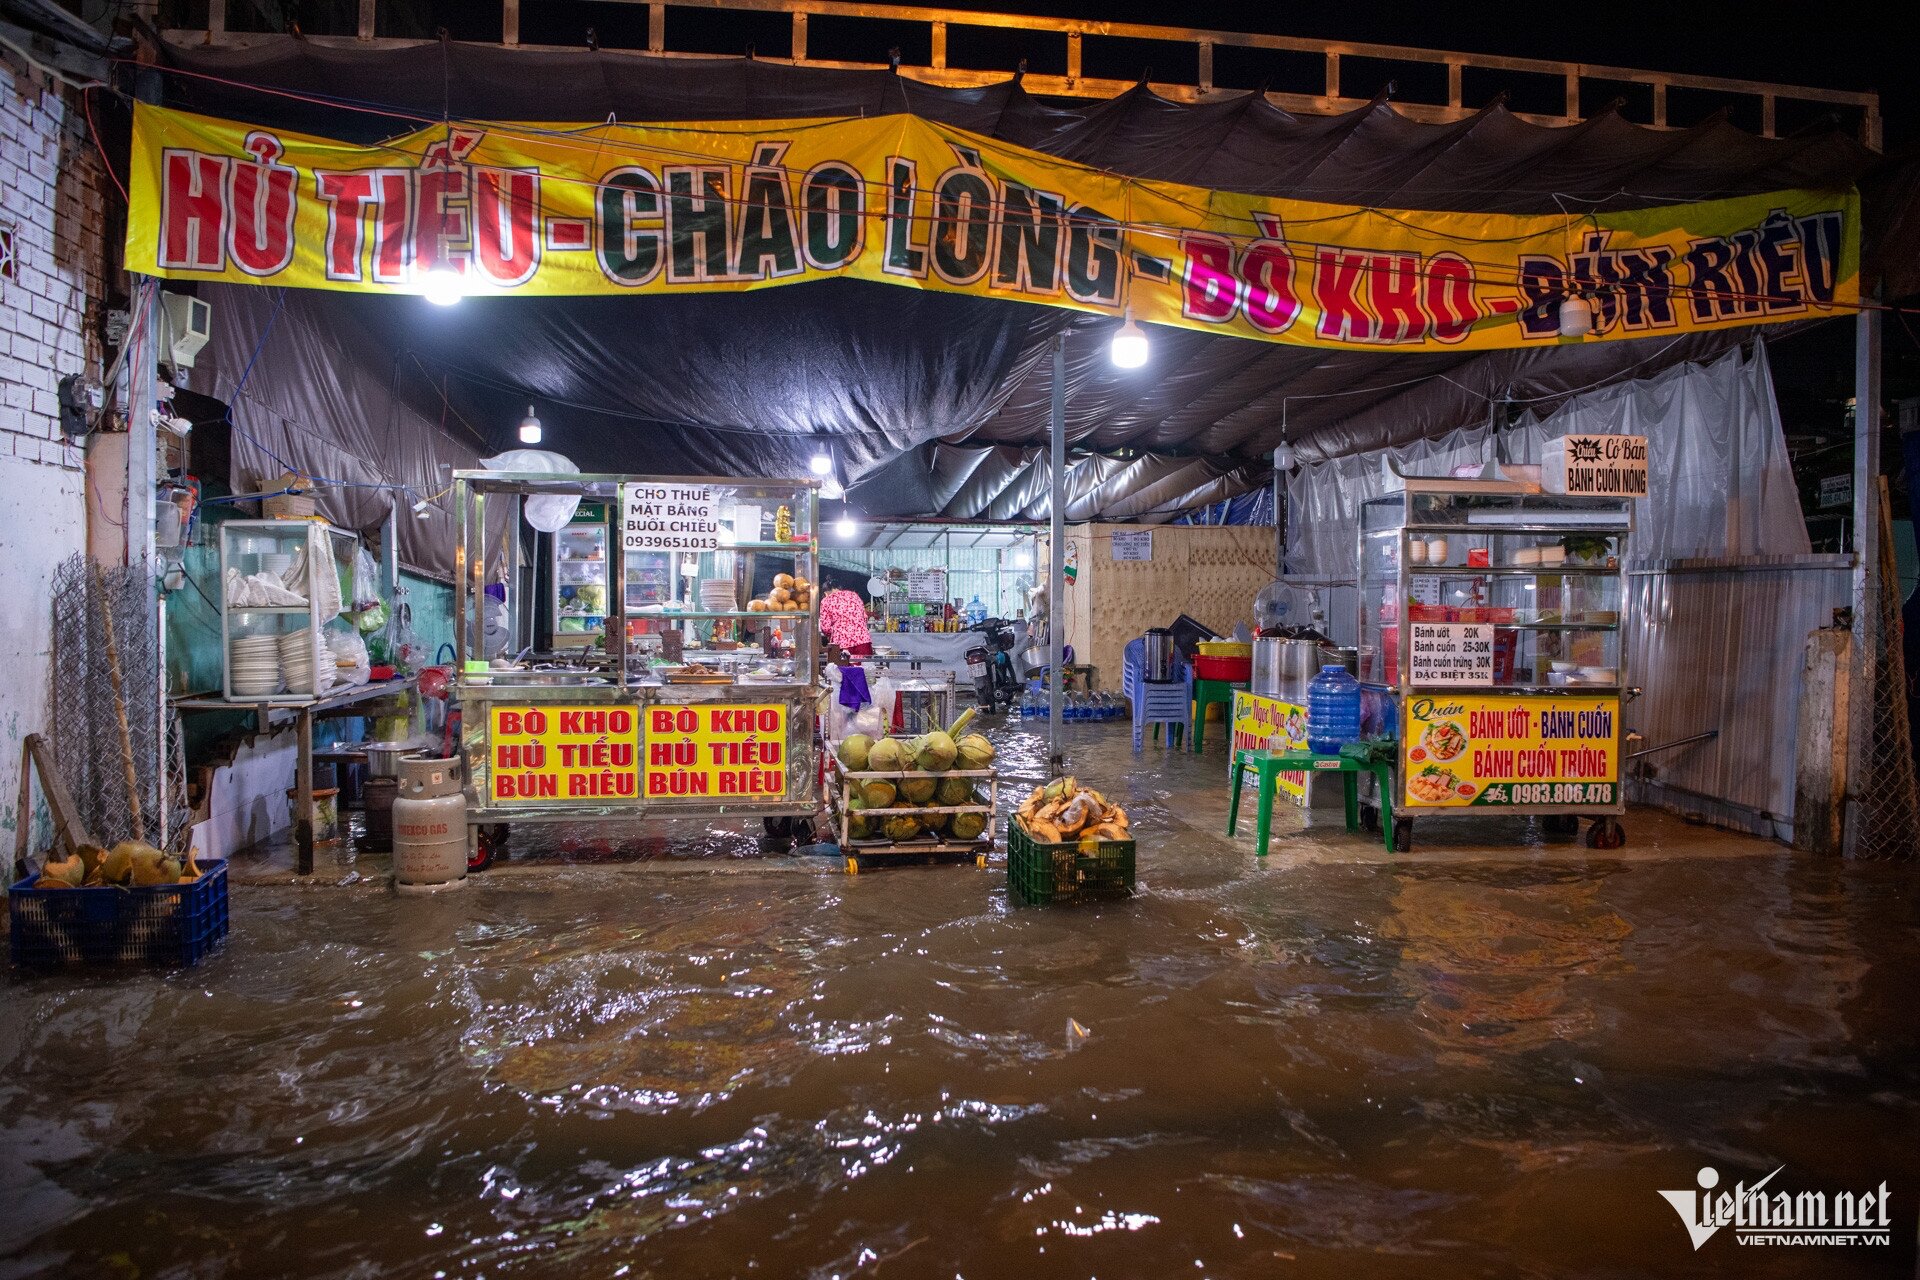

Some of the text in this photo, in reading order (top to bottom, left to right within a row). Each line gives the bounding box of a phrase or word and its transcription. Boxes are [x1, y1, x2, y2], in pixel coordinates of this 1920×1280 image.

[158, 130, 298, 276] HỦ
[594, 140, 865, 287] CHÁO
[881, 141, 1127, 308] LÒNG
[1178, 210, 1302, 335] BÒ
[1311, 244, 1483, 344] KHO
[1517, 230, 1678, 340] BÚN
[1683, 207, 1843, 324] RIÊU
[1606, 438, 1621, 459] Có
[1622, 439, 1646, 460] Bán
[1568, 462, 1645, 493] BÁNH CUỐN NÓNG
[635, 488, 710, 500] CHO THUÊ
[631, 502, 662, 517] MẶT
[670, 519, 716, 532] CHIỀU
[626, 536, 717, 548] 0939651013
[1415, 627, 1479, 638] Bánh ướt 20K
[1415, 639, 1490, 652] Bánh cuốn 25-30K
[1413, 654, 1490, 670] Bánh cuốn trứng 30K
[1415, 670, 1438, 680] ĐẶC
[1441, 670, 1465, 681] BIỆT
[652, 707, 780, 733] BÒ KHO
[1253, 699, 1269, 728] Ngọc
[1412, 699, 1465, 721] Quán
[1470, 705, 1503, 739] BÁNH
[1507, 705, 1530, 739] ƯỚT
[1541, 705, 1574, 738] BÁNH
[1578, 702, 1611, 739] CUỐN
[499, 708, 631, 736] BÒ KHO
[498, 736, 633, 768] HỦ TIẾU
[651, 734, 781, 766] HỦ TIẾU
[1474, 741, 1606, 778] BÁNH CUỐN TRỨNG
[496, 769, 635, 797] BÚN RIÊU
[649, 767, 783, 795] BÚN RIÊU
[1512, 783, 1611, 804] 0983.806.478
[430, 823, 448, 835] GAS
